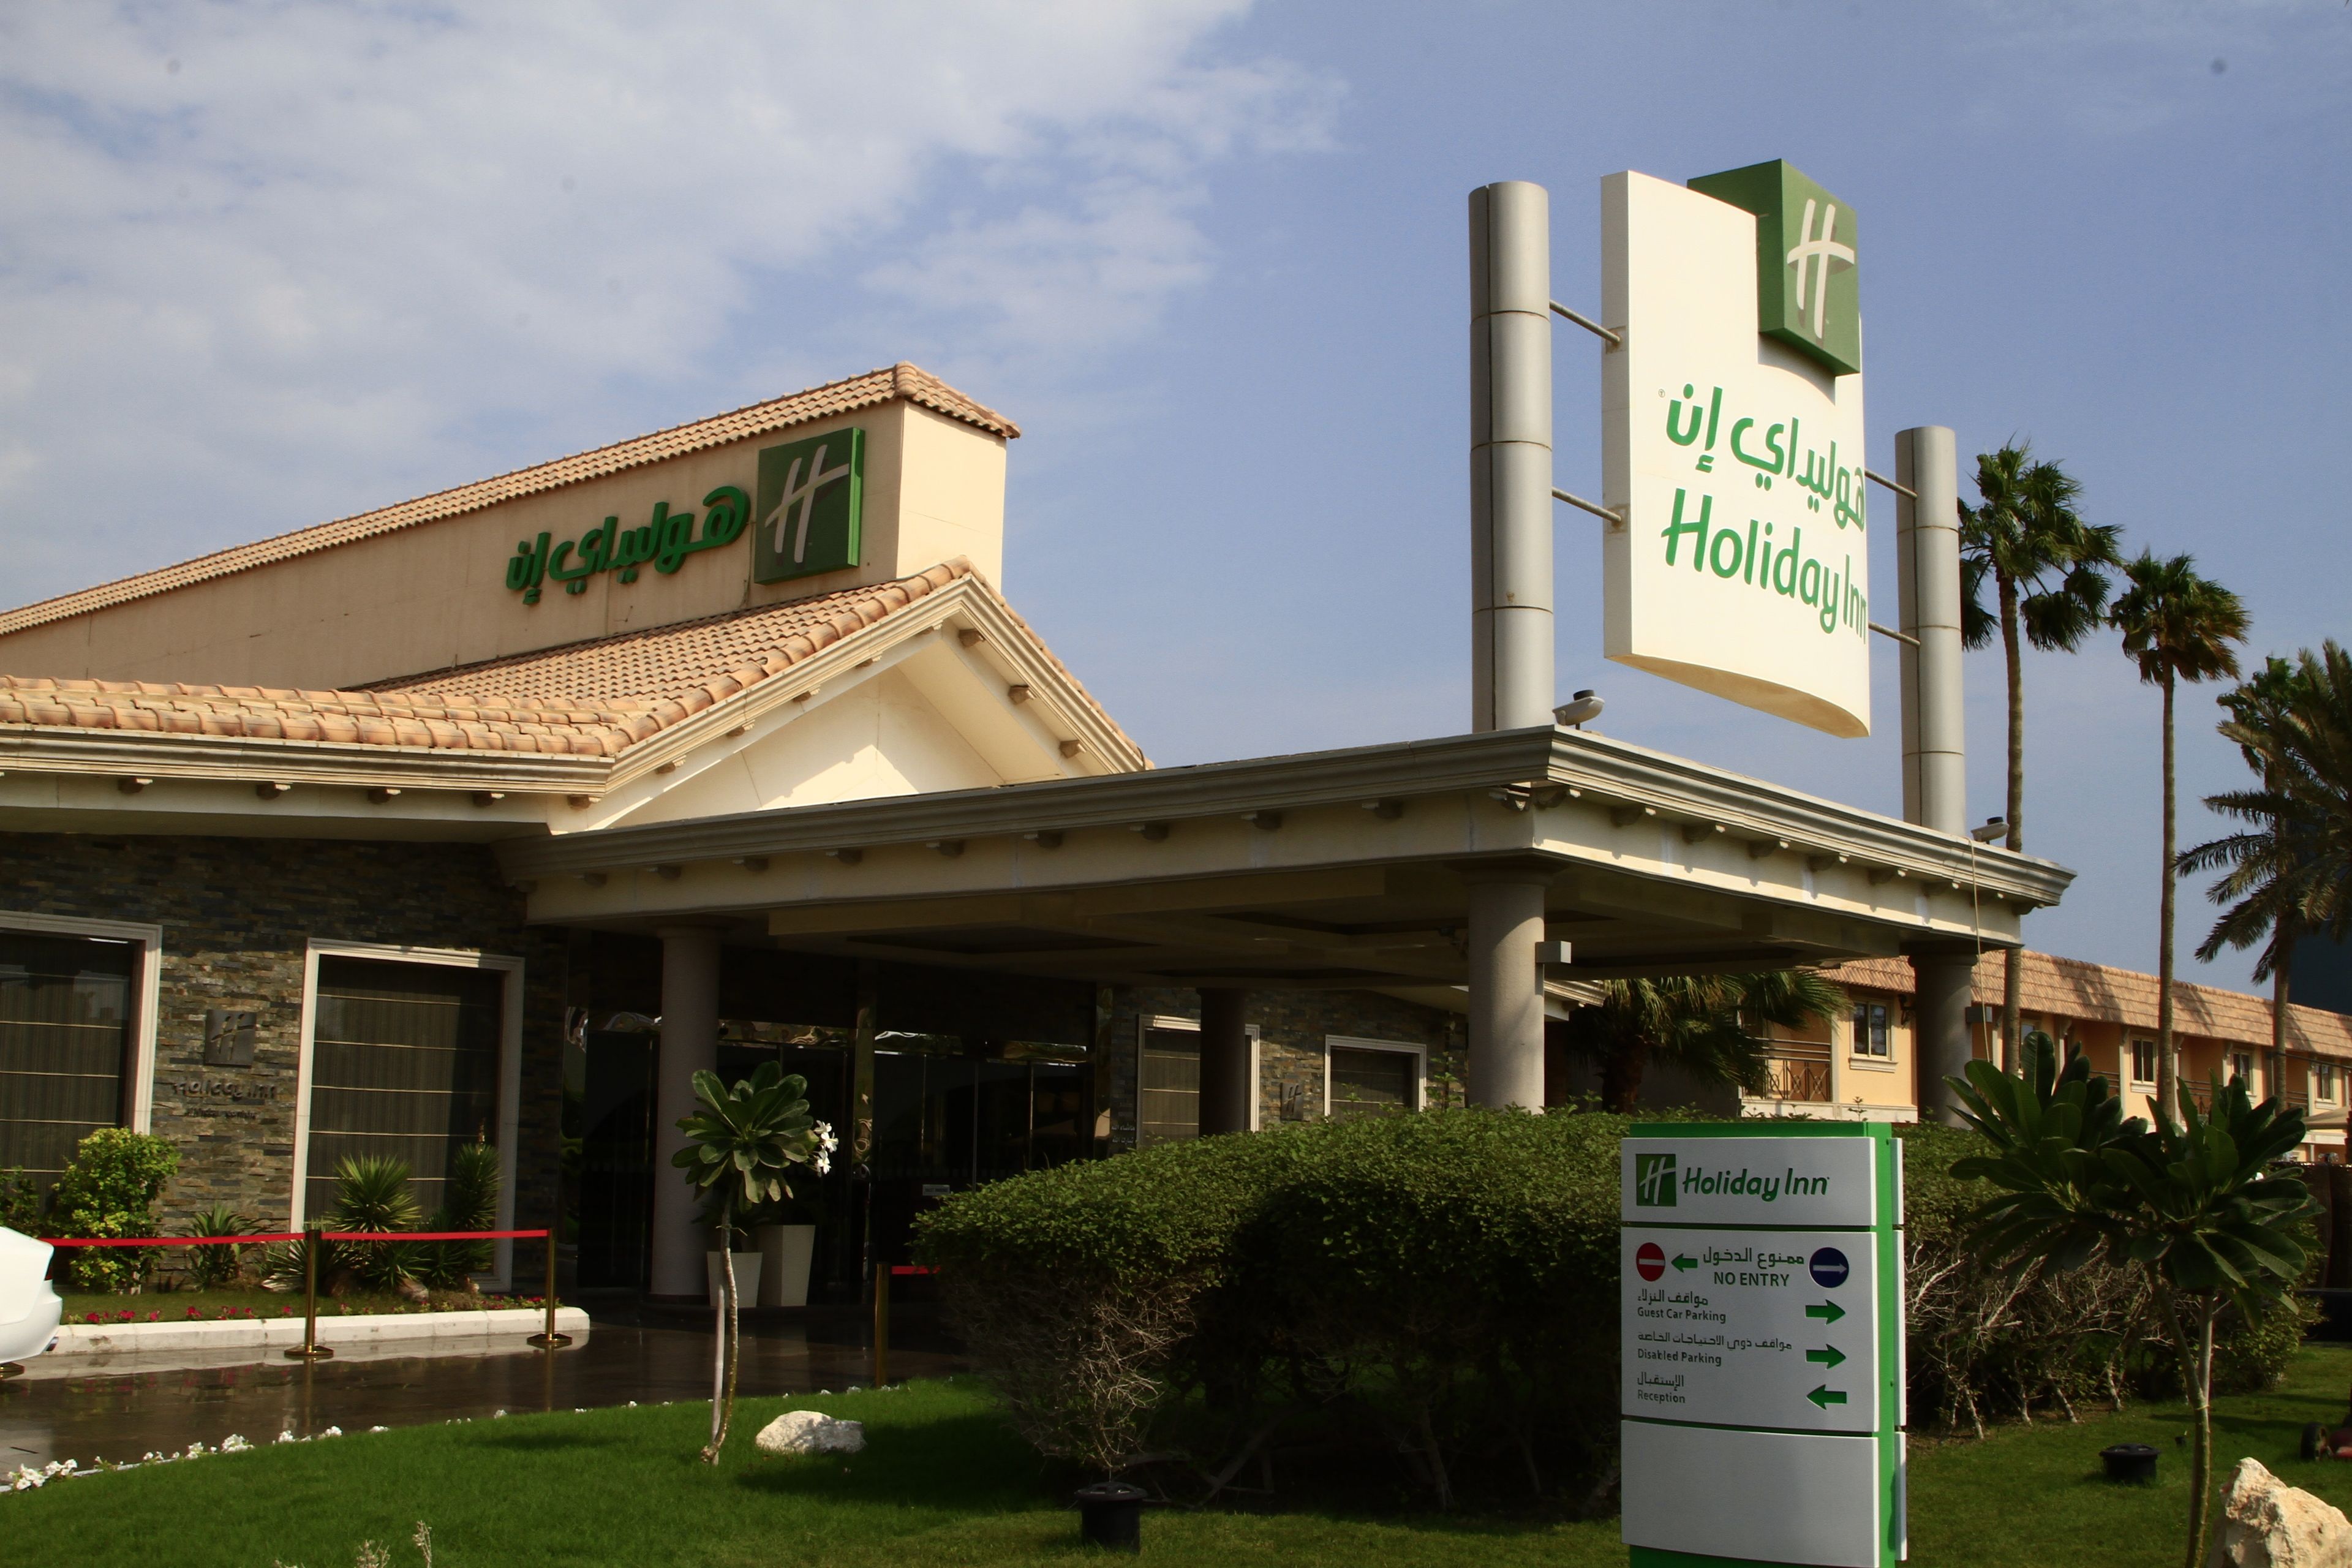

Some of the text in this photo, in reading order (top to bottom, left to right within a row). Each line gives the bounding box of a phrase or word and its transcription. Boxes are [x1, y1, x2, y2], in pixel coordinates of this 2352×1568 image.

[1666, 383, 1865, 532] هوليداي إن
[506, 486, 752, 605] هوليداي إن
[1661, 488, 1867, 645] Holiday Inn
[172, 1079, 277, 1101] Holiday Inn
[1683, 1167, 1780, 1202] Holiday
[1784, 1167, 1828, 1196] Inn
[1703, 1246, 1804, 1270] ممنوع الدخول
[1714, 1272, 1790, 1287] NO ENTRY
[1637, 1288, 1709, 1308] مواقف النزلاء
[1637, 1307, 1727, 1324] Guest Car Parking
[1638, 1331, 1792, 1351] مواقف ذوي الاحتياجات الخاصة
[1637, 1349, 1722, 1367] Disabled Parking
[1637, 1389, 1686, 1404] Reception
